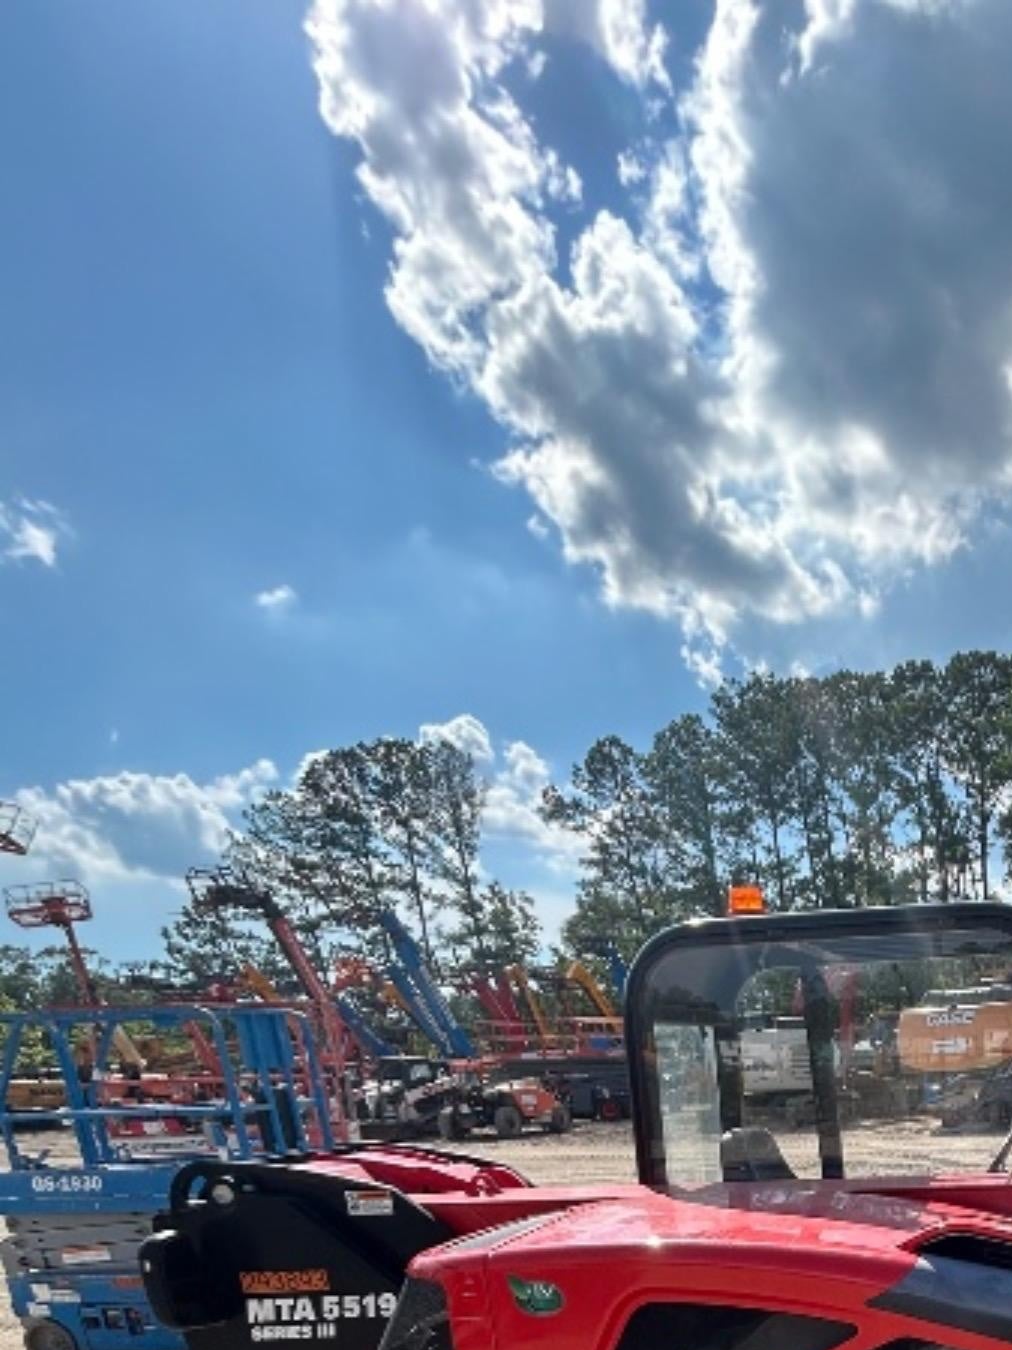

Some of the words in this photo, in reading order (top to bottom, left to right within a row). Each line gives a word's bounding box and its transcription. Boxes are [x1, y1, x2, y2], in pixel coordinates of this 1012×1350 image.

[247, 1298, 316, 1323] MTA
[322, 1292, 398, 1320] 5519
[250, 1324, 312, 1342] SERIES
[316, 1322, 336, 1339] III
